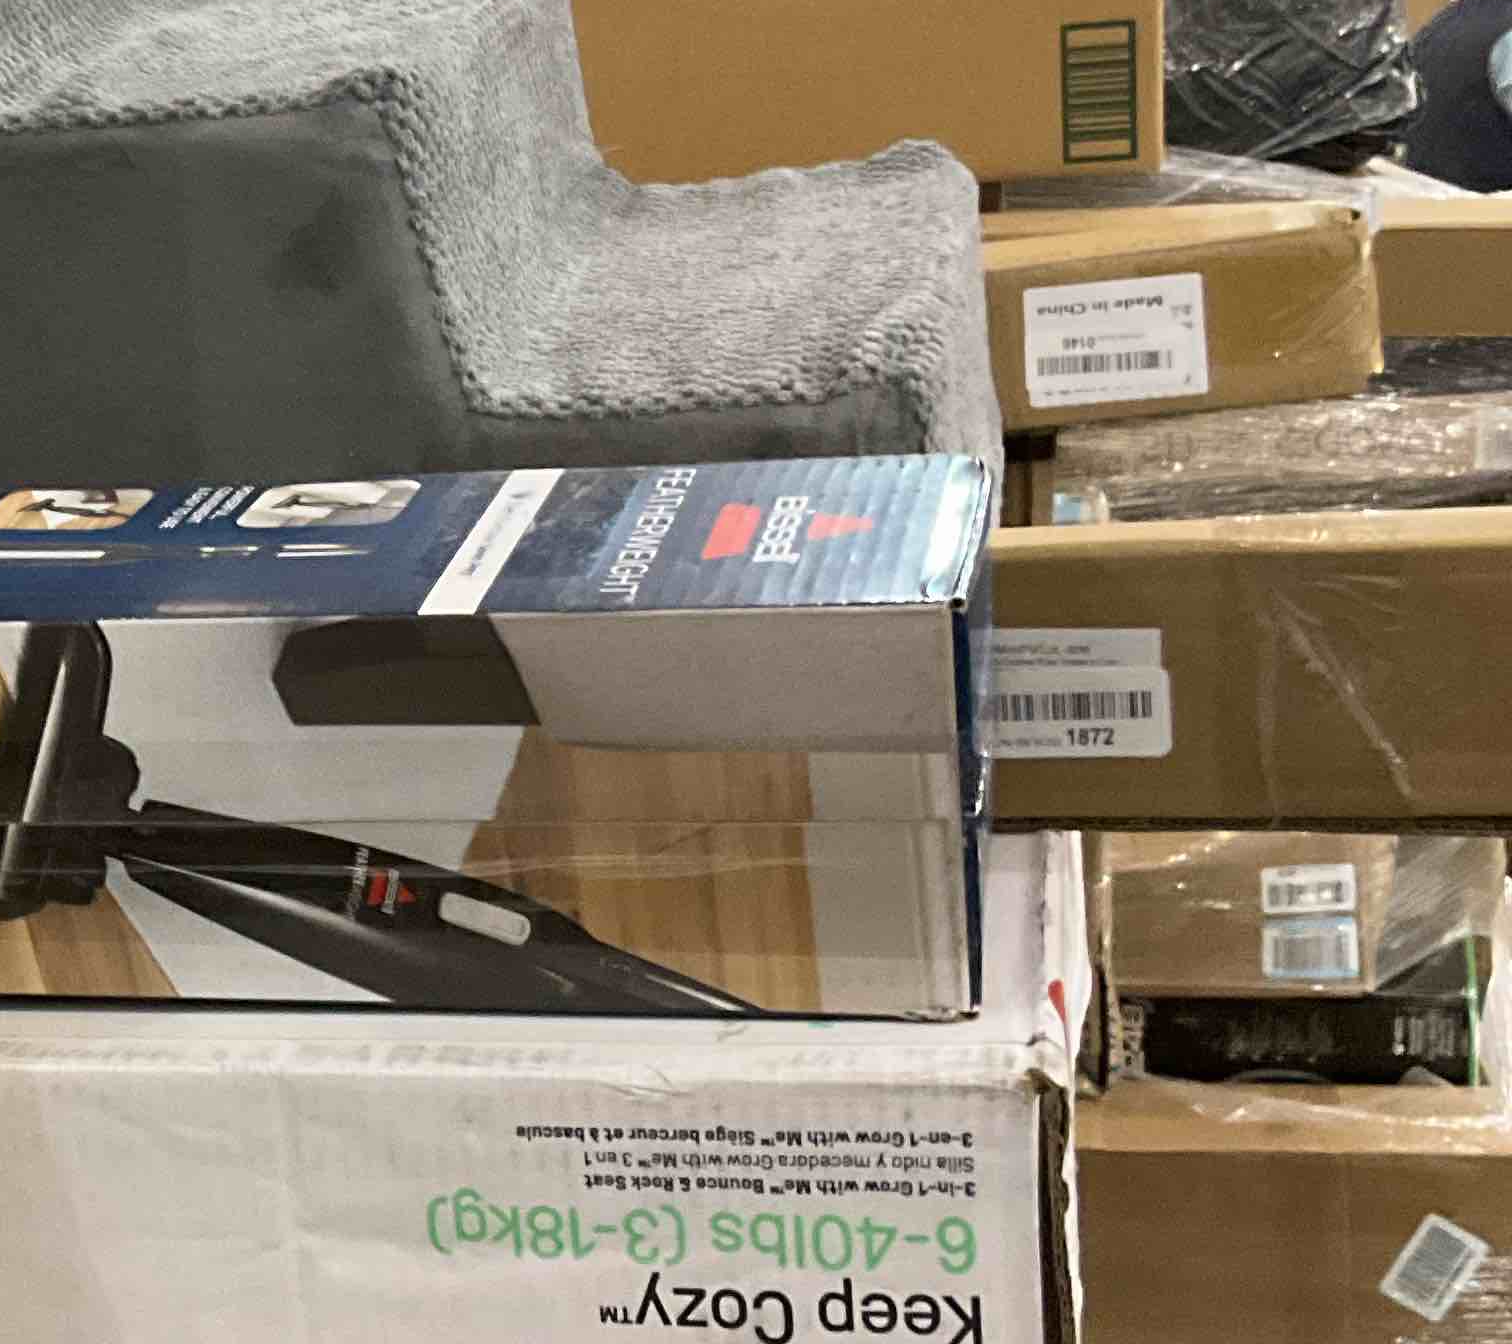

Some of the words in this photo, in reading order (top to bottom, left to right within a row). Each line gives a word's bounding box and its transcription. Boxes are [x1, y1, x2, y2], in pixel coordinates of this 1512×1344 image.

[515, 1125, 585, 1143] bascule
[603, 1127, 624, 1142] et
[628, 1128, 700, 1146] berceur
[807, 1131, 851, 1148] with
[855, 1131, 904, 1148] Grow
[909, 1132, 973, 1148] 3-en-1
[583, 1150, 593, 1167] 1
[595, 1151, 617, 1165] en
[621, 1151, 632, 1167] 3
[681, 1152, 723, 1171] with
[726, 1153, 774, 1171] Grow
[777, 1154, 871, 1172] mecedora
[875, 1152, 887, 1168] y
[891, 1155, 932, 1173] nido
[935, 1155, 975, 1173] Silla
[583, 1173, 627, 1192] Seat
[630, 1175, 675, 1193] Rock
[678, 1176, 692, 1193] &
[695, 1176, 765, 1195] Bounce
[816, 1178, 859, 1197] with
[862, 1179, 913, 1197] Grow
[918, 1179, 977, 1198] 3-in-1
[426, 1187, 687, 1266] (3-18kg)
[710, 1214, 977, 1275] 6-40lbs
